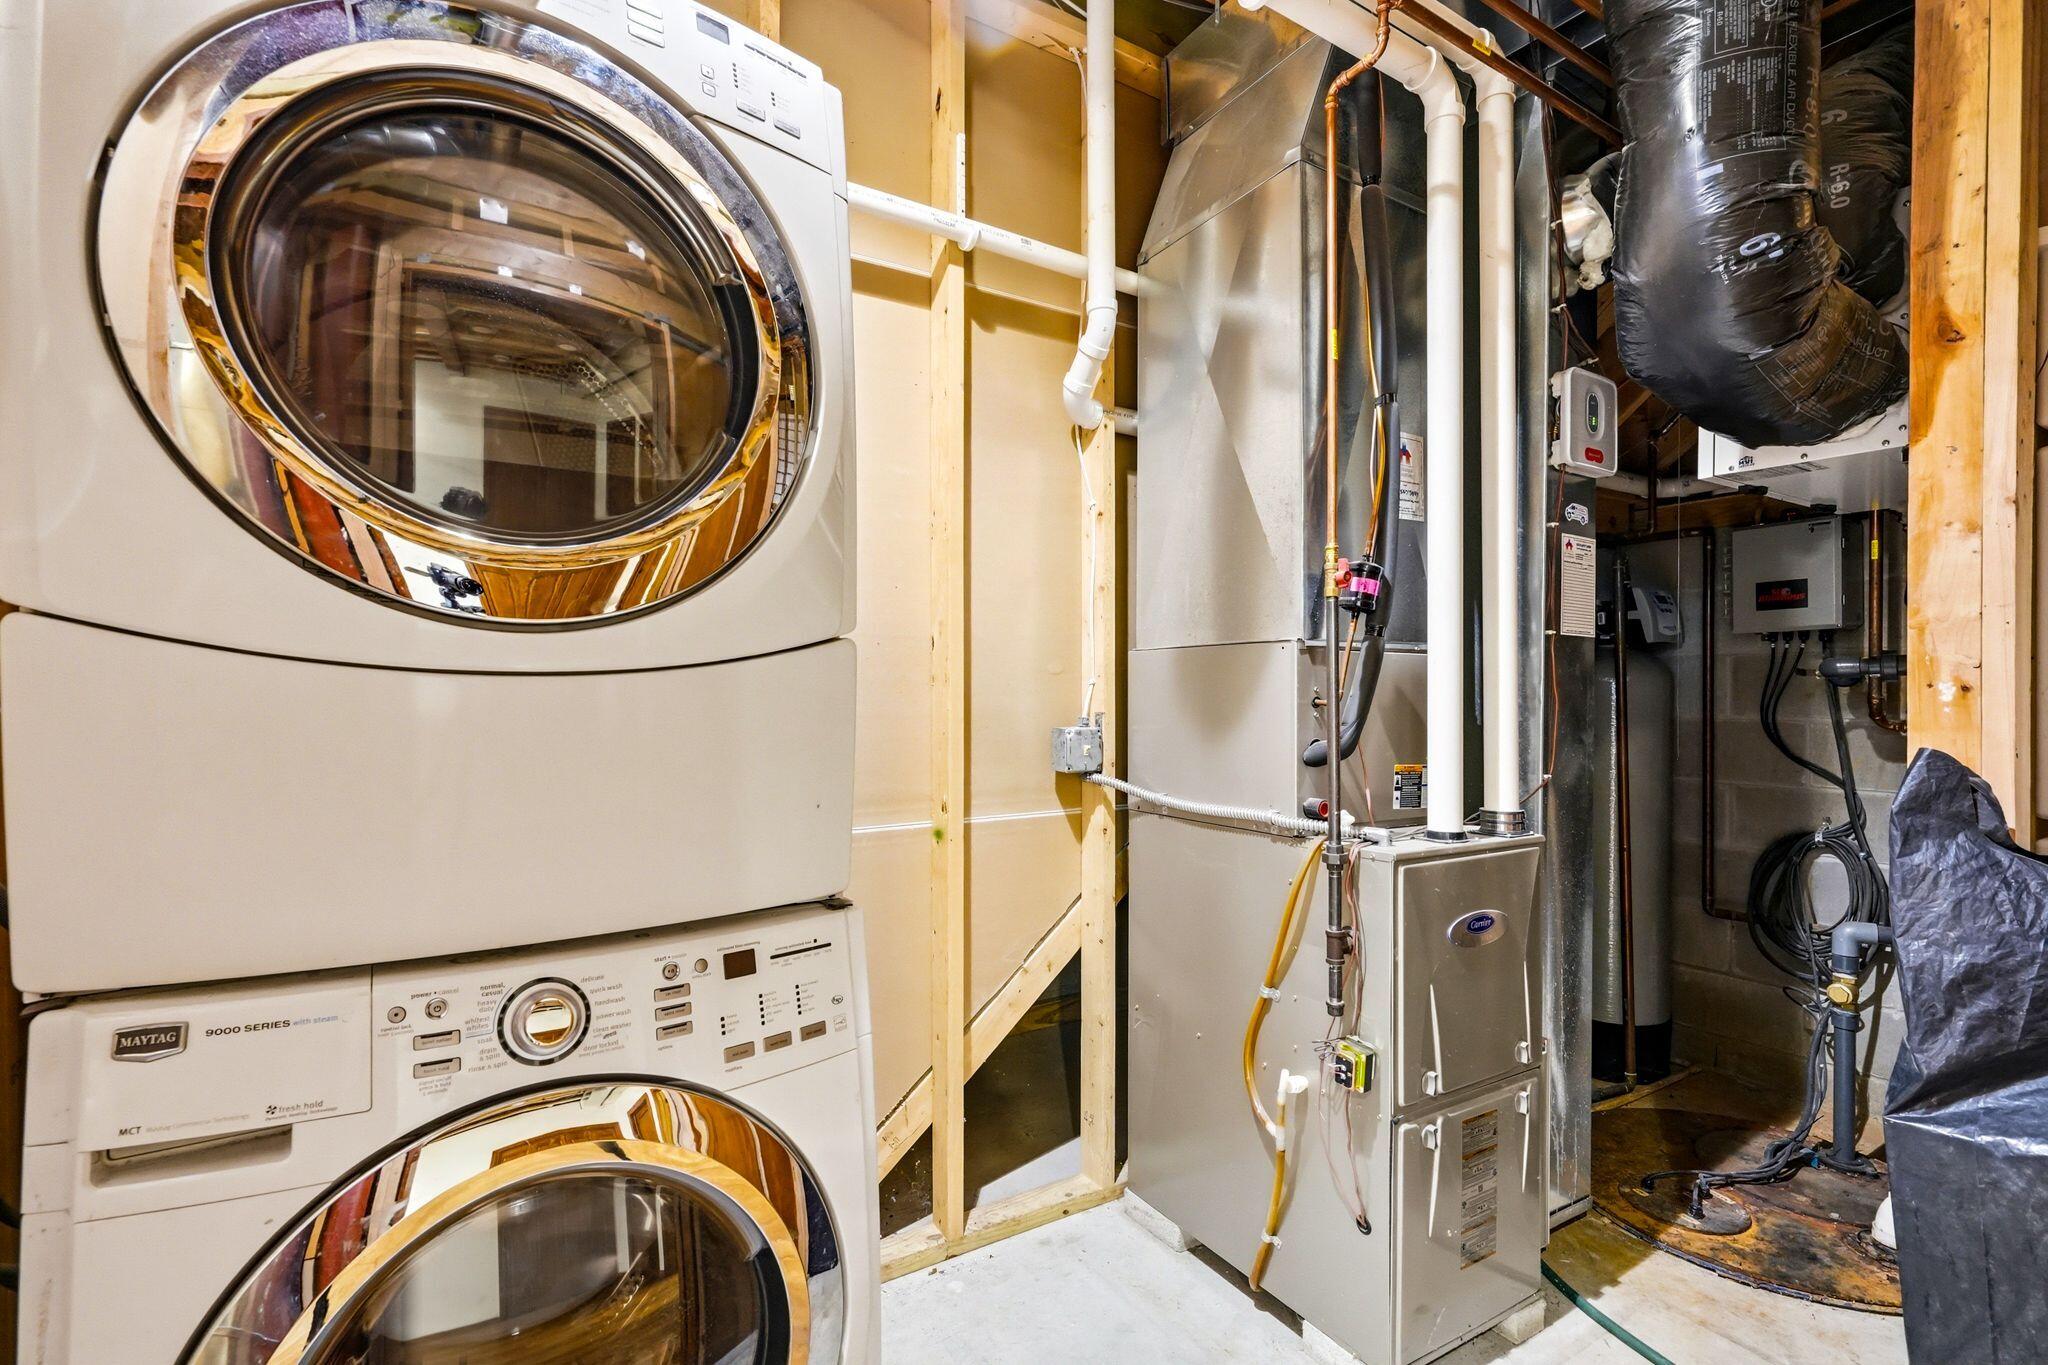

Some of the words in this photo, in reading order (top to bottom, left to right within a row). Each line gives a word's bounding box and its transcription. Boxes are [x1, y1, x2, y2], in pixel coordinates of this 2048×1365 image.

[1787, 21, 1799, 77] FLEXIBLE
[1786, 78, 1796, 100] AIR
[1786, 102, 1796, 134] DUCT
[1829, 163, 1851, 209] R-6.0
[1470, 918, 1492, 930] Carrier
[481, 989, 504, 997] casual
[607, 983, 623, 991] wash
[410, 992, 432, 1000] power
[477, 998, 497, 1007] heavy
[478, 1006, 494, 1014] duty
[205, 1026, 242, 1037] 9000
[244, 1020, 291, 1033] SERIES
[293, 1018, 311, 1026] with
[313, 1015, 338, 1024] steam
[119, 1032, 177, 1048] MAYTAG
[278, 1104, 302, 1114] fresh
[303, 1100, 324, 1110] hold
[118, 1126, 142, 1137] MCT
